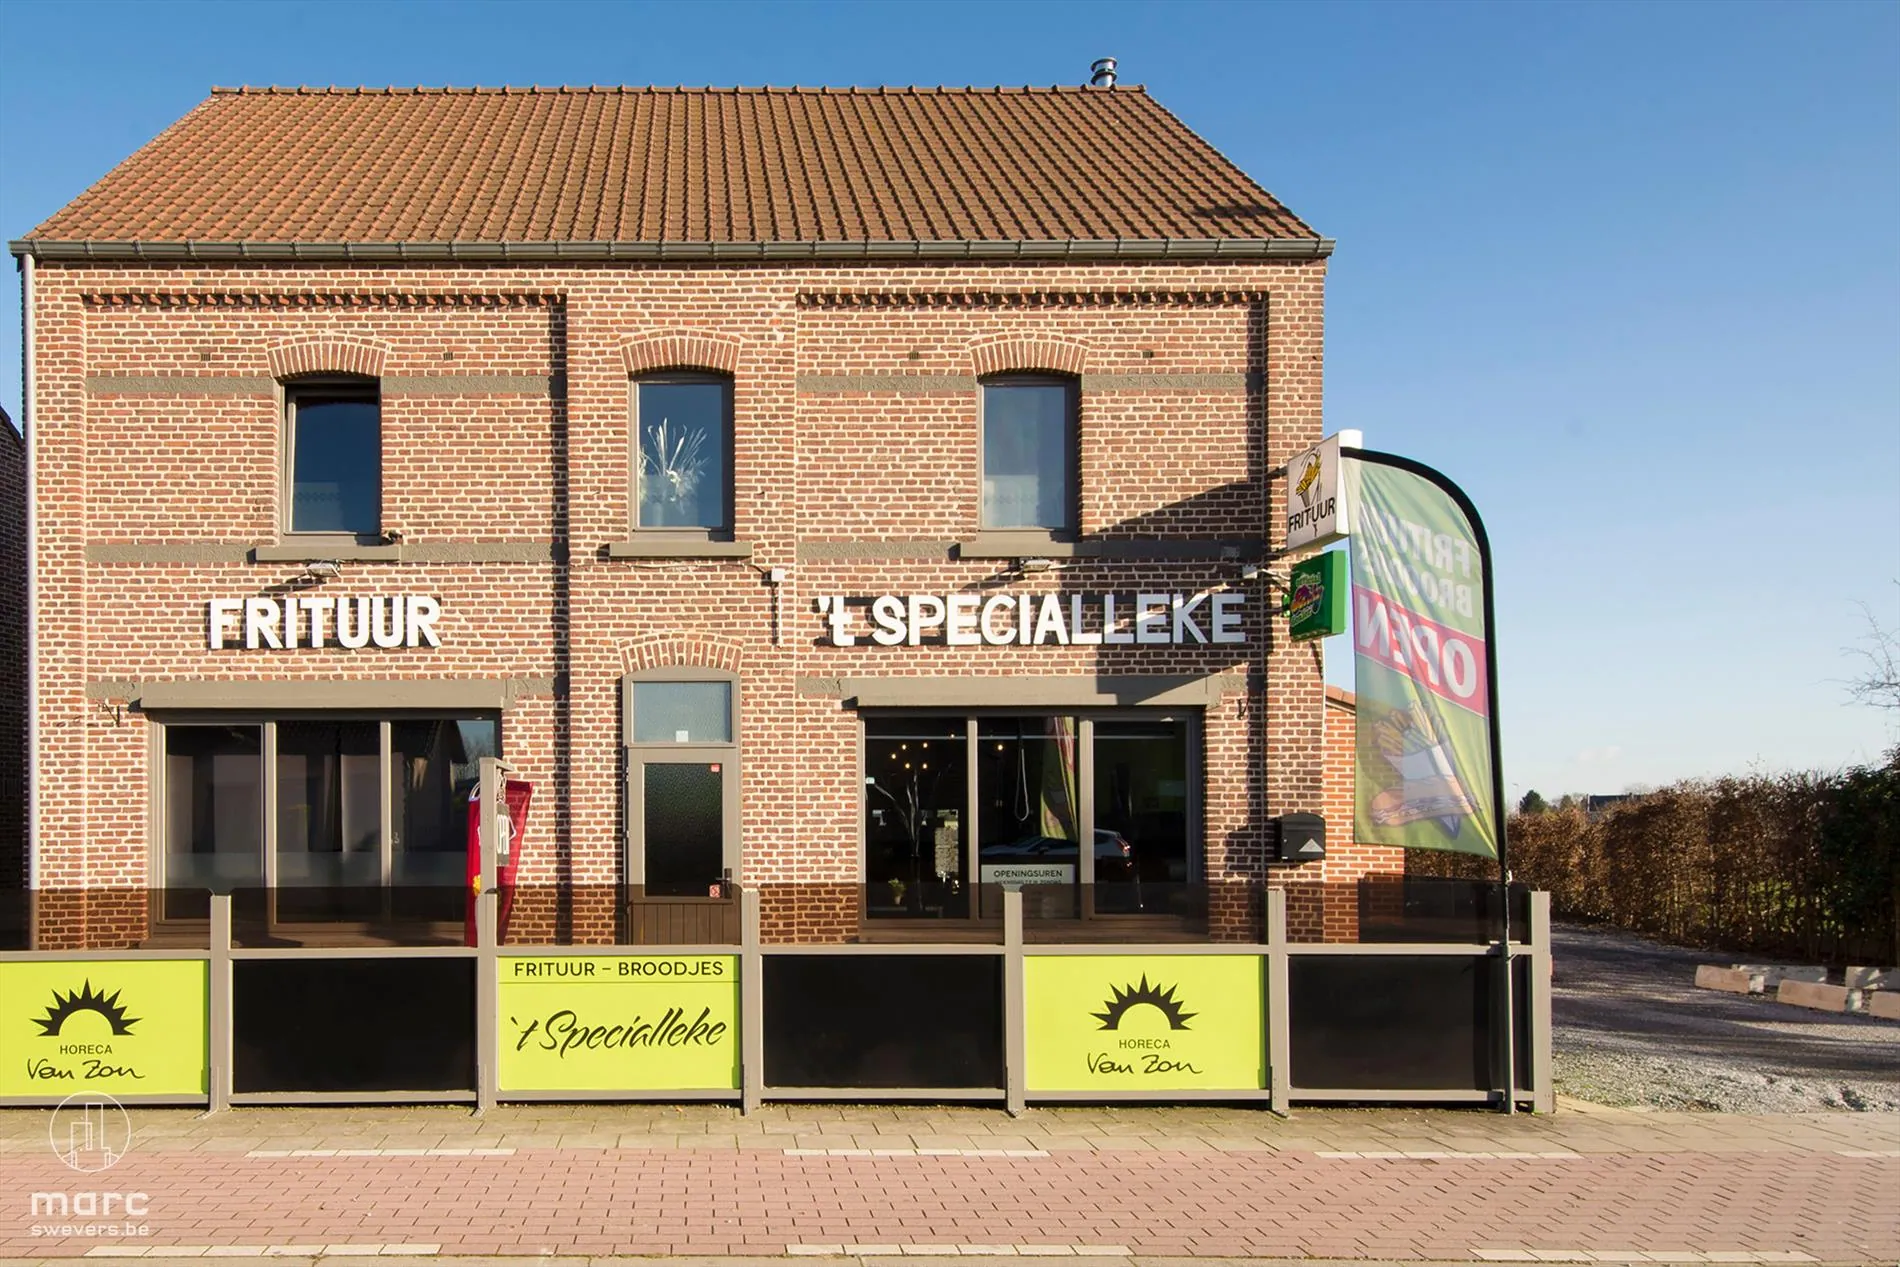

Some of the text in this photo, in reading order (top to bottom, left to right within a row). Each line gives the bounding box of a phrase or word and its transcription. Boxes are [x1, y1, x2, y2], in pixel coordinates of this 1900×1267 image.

[1288, 497, 1336, 533] FRITUUR
[210, 596, 443, 649] FRITUUR
[871, 594, 1247, 646] SPECIALLEKE
[993, 869, 1063, 878] OPENINGSUREN
[514, 961, 595, 976] FRITUUR
[618, 961, 724, 976] BROODJES
[538, 1006, 727, 1060] Specialleke
[1118, 1038, 1171, 1049] HORECA
[59, 1044, 113, 1055] HORECA
[27, 1058, 146, 1080] Van Zon
[1086, 1052, 1204, 1075] Van Zon
